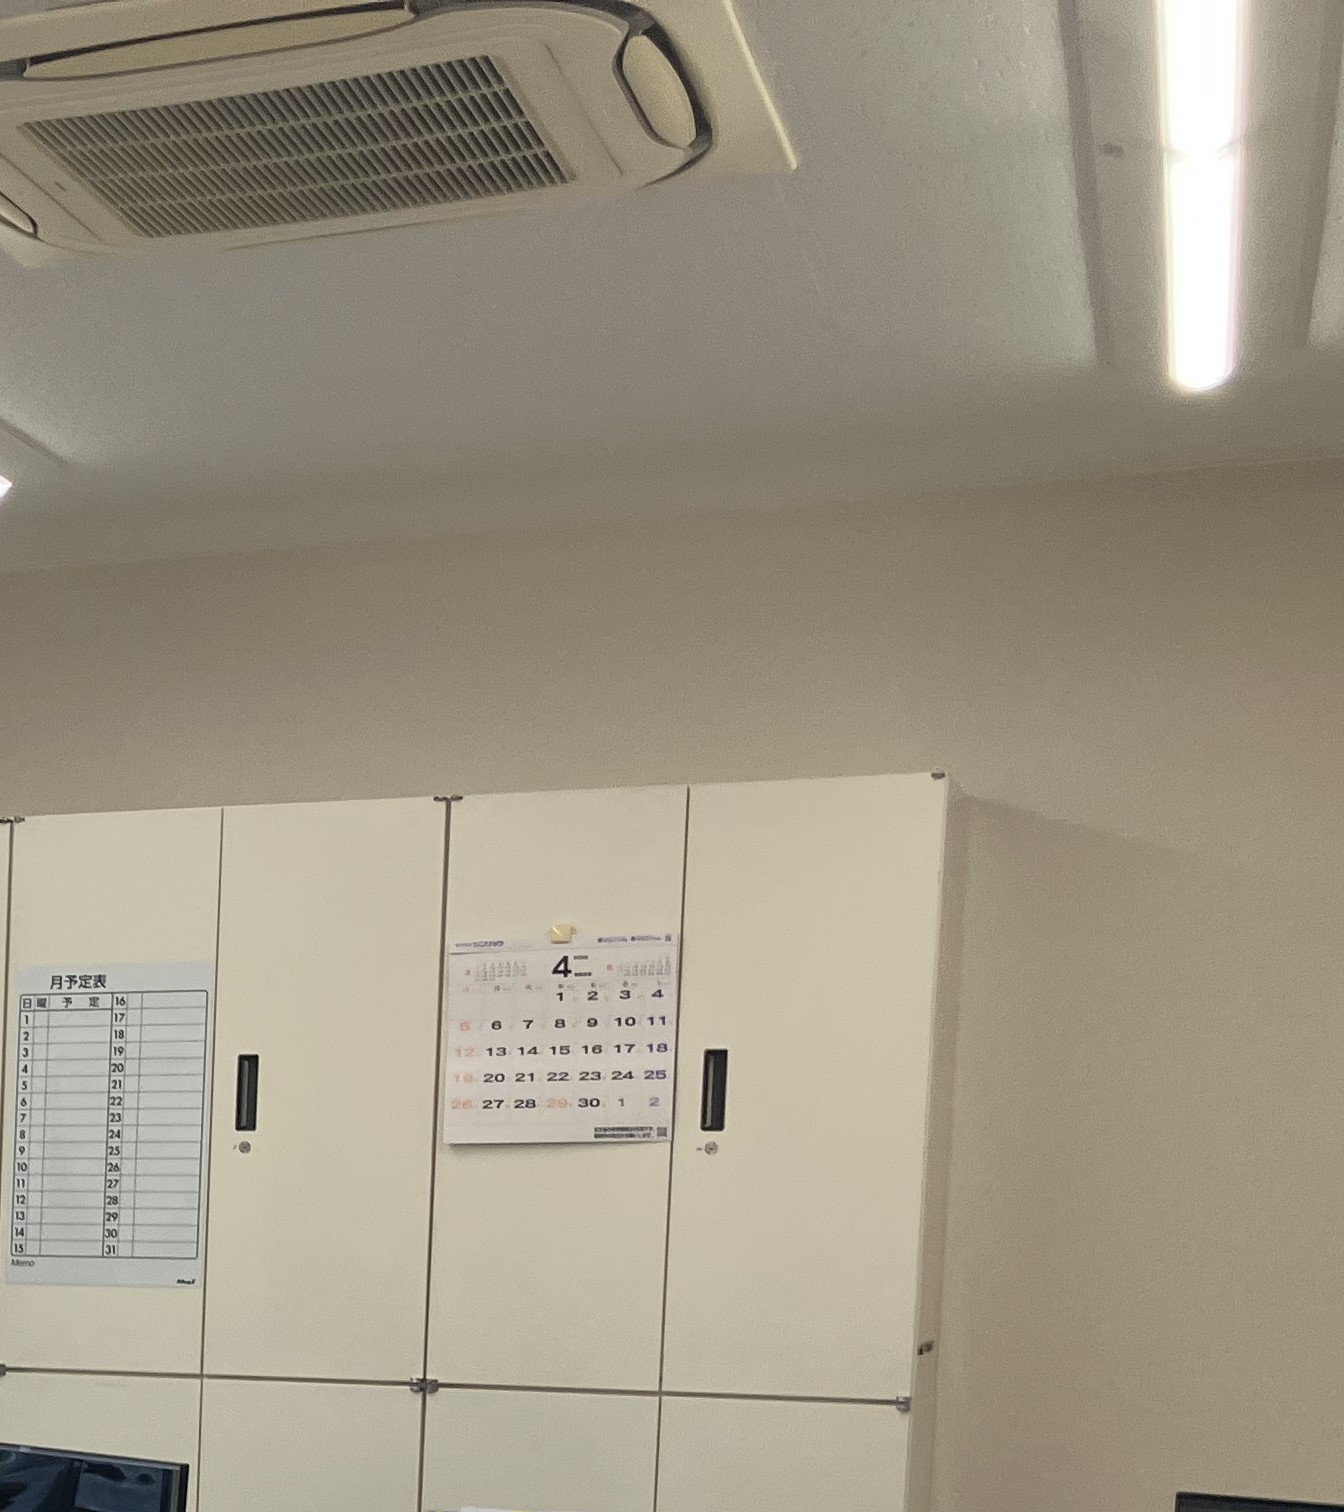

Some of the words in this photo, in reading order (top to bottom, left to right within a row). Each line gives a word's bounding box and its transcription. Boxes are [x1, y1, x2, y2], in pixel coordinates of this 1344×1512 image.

[551, 955, 572, 978] 4
[50, 974, 107, 990] 月予定表
[556, 992, 563, 1001] 1
[587, 991, 599, 1001] 2
[619, 990, 631, 1000] 3
[651, 989, 664, 998] 4
[22, 997, 32, 1009] 日
[115, 996, 126, 1006] 16
[24, 1015, 29, 1025] 1
[114, 1012, 126, 1022] 17
[491, 1020, 502, 1030] 6
[522, 1020, 534, 1029] 7
[554, 1019, 566, 1028] 8
[587, 1018, 598, 1028] 9
[614, 1016, 636, 1026] 10
[647, 1016, 666, 1026] 11
[23, 1032, 30, 1041] 2
[114, 1029, 124, 1040] 18
[22, 1048, 29, 1058] 3
[112, 1046, 124, 1056] 19
[486, 1047, 507, 1056] 13
[517, 1046, 538, 1056] 14
[549, 1045, 570, 1055] 15
[582, 1045, 602, 1054] 16
[614, 1044, 636, 1053] 17
[646, 1043, 668, 1053] 18
[22, 1064, 28, 1074] 4
[111, 1062, 124, 1072] 20
[483, 1073, 505, 1083] 20
[515, 1072, 534, 1082] 21
[546, 1072, 570, 1082] 22
[579, 1071, 602, 1081] 23
[612, 1070, 634, 1080] 24
[644, 1070, 667, 1080] 25
[20, 1080, 28, 1090] 5
[111, 1080, 122, 1090] 21
[20, 1097, 27, 1107] 6
[109, 1096, 122, 1106] 22
[482, 1100, 505, 1110] 27
[514, 1099, 536, 1109] 28
[578, 1098, 600, 1108] 30
[618, 1098, 624, 1107] 1
[649, 1097, 660, 1107] 2
[20, 1114, 27, 1122] 7
[109, 1113, 122, 1122] 23
[19, 1130, 26, 1140] 8
[108, 1130, 121, 1139] 24
[18, 1146, 26, 1156] 9
[108, 1146, 120, 1156] 25
[16, 1162, 28, 1172] 10
[107, 1162, 120, 1172] 26
[16, 1178, 25, 1188] 11
[106, 1179, 119, 1189] 27
[16, 1194, 26, 1204] 12
[106, 1196, 119, 1206] 28
[15, 1211, 25, 1221] 13
[105, 1212, 118, 1222] 29
[14, 1227, 24, 1237] 14
[104, 1228, 118, 1238] 30
[14, 1244, 24, 1253] 15
[104, 1245, 116, 1254] 31
